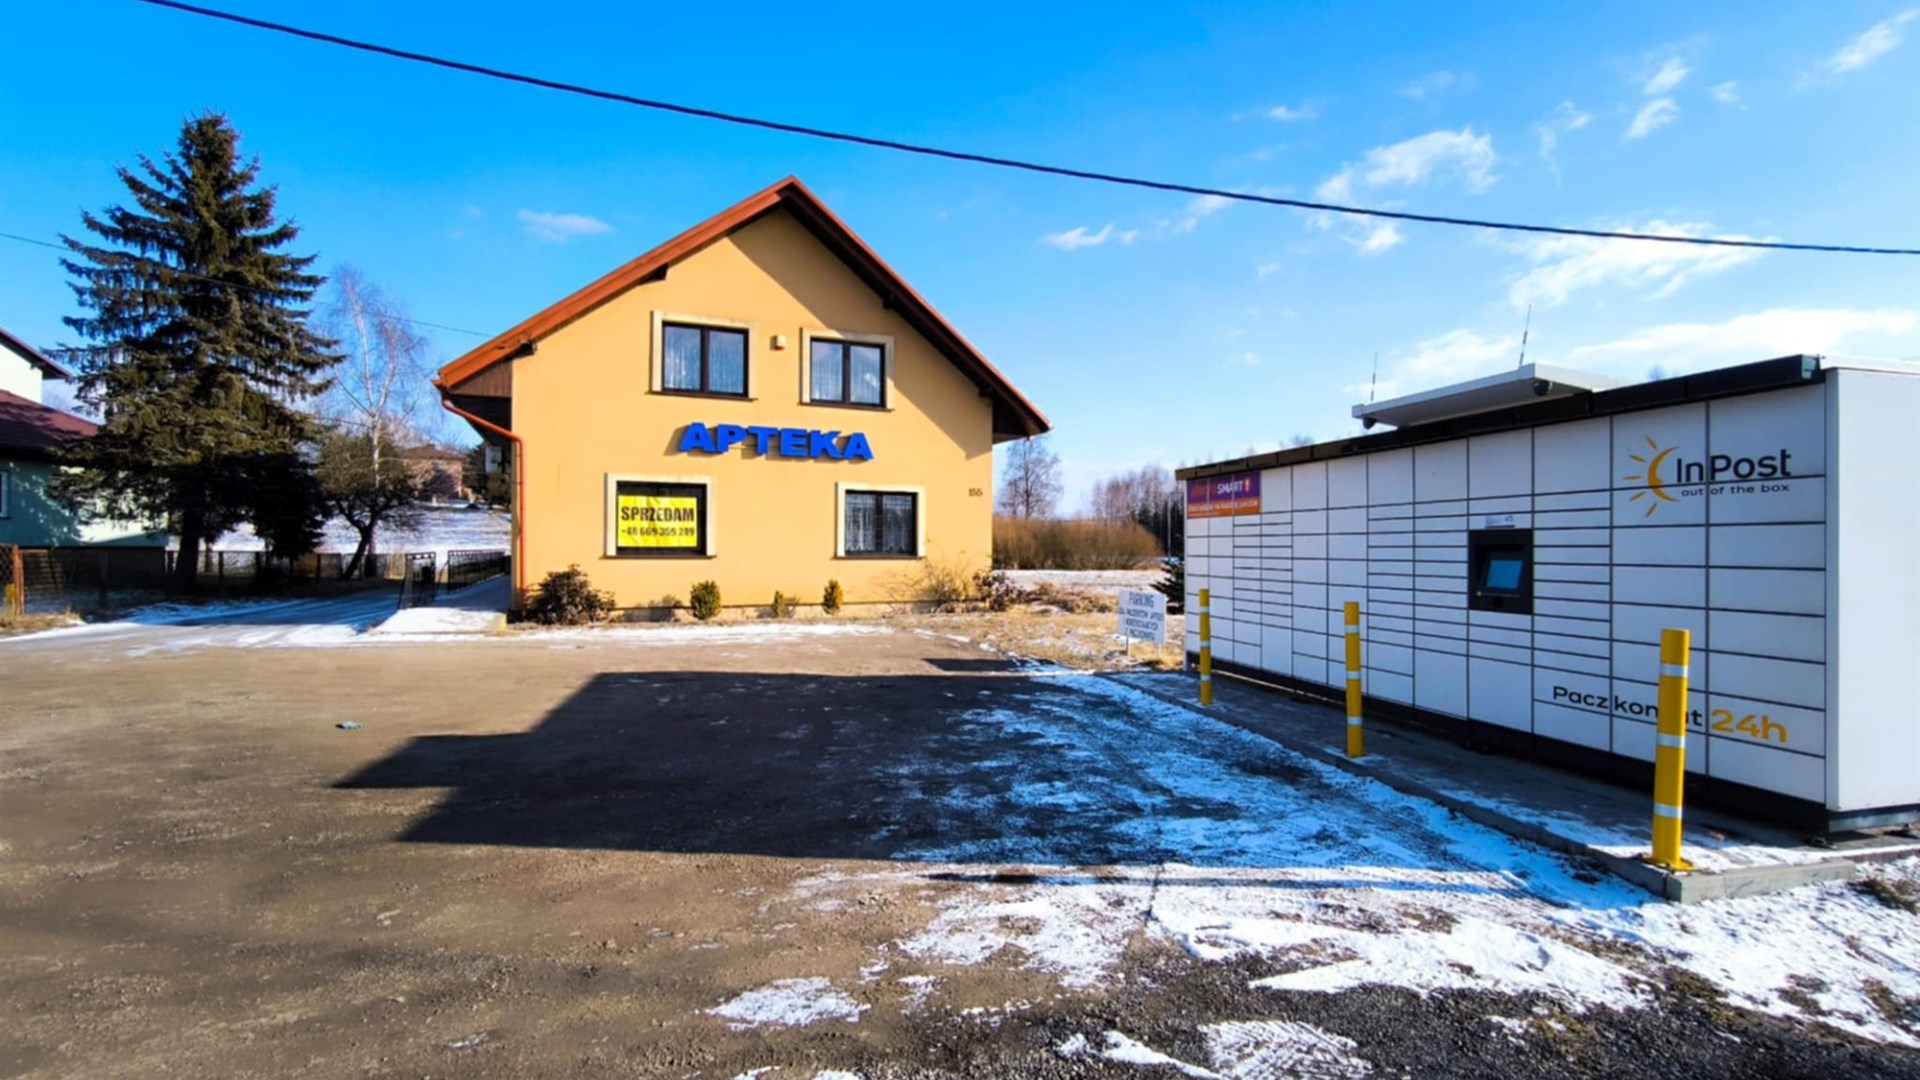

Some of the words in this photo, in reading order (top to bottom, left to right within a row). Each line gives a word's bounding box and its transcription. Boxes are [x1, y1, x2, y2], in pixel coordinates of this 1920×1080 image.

[679, 422, 873, 460] APTEKA
[1676, 449, 1792, 483] InPost
[1681, 488, 1704, 497] out
[1710, 486, 1724, 496] of
[1730, 484, 1755, 495] the
[1761, 483, 1790, 493] box
[621, 506, 694, 522] SPRZEDAM
[1553, 685, 1703, 728] Paczkot
[1711, 708, 1787, 743] 24h
